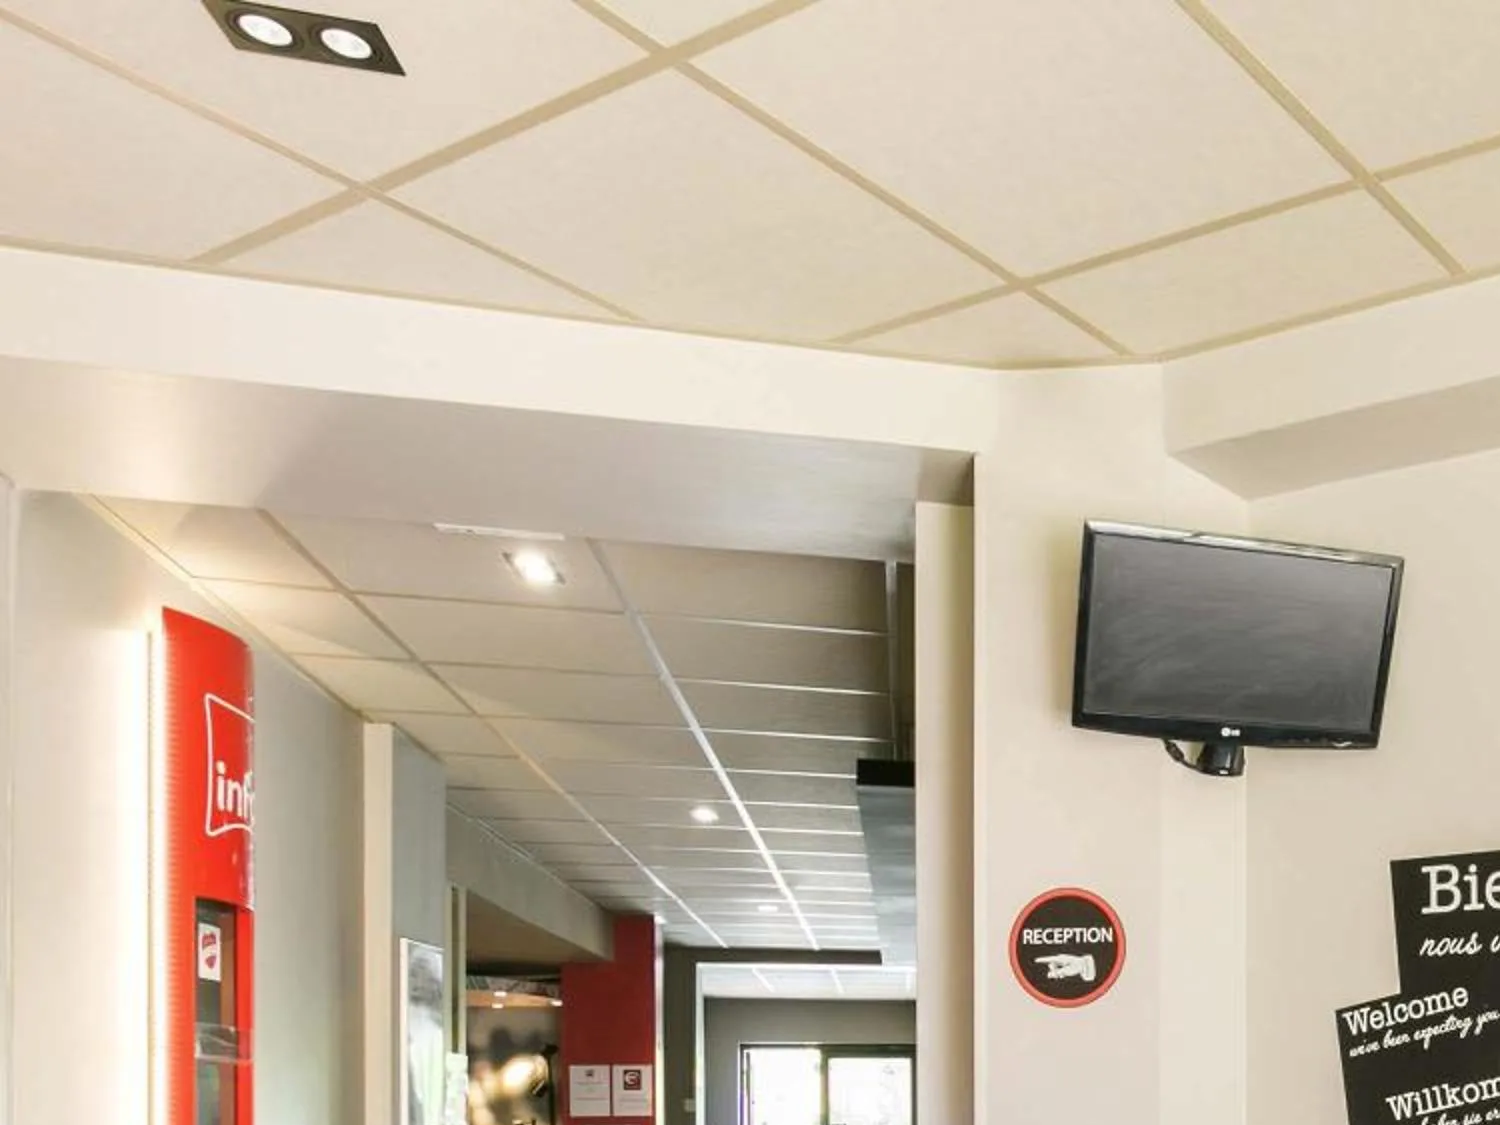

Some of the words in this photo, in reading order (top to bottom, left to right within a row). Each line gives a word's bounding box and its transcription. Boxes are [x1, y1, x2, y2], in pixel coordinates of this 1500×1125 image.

[1023, 927, 1113, 945] RECEPTION
[1419, 932, 1482, 956] nous
[1342, 987, 1469, 1036] Welcome
[1383, 1029, 1410, 1048] been
[1414, 1014, 1473, 1050] expecting
